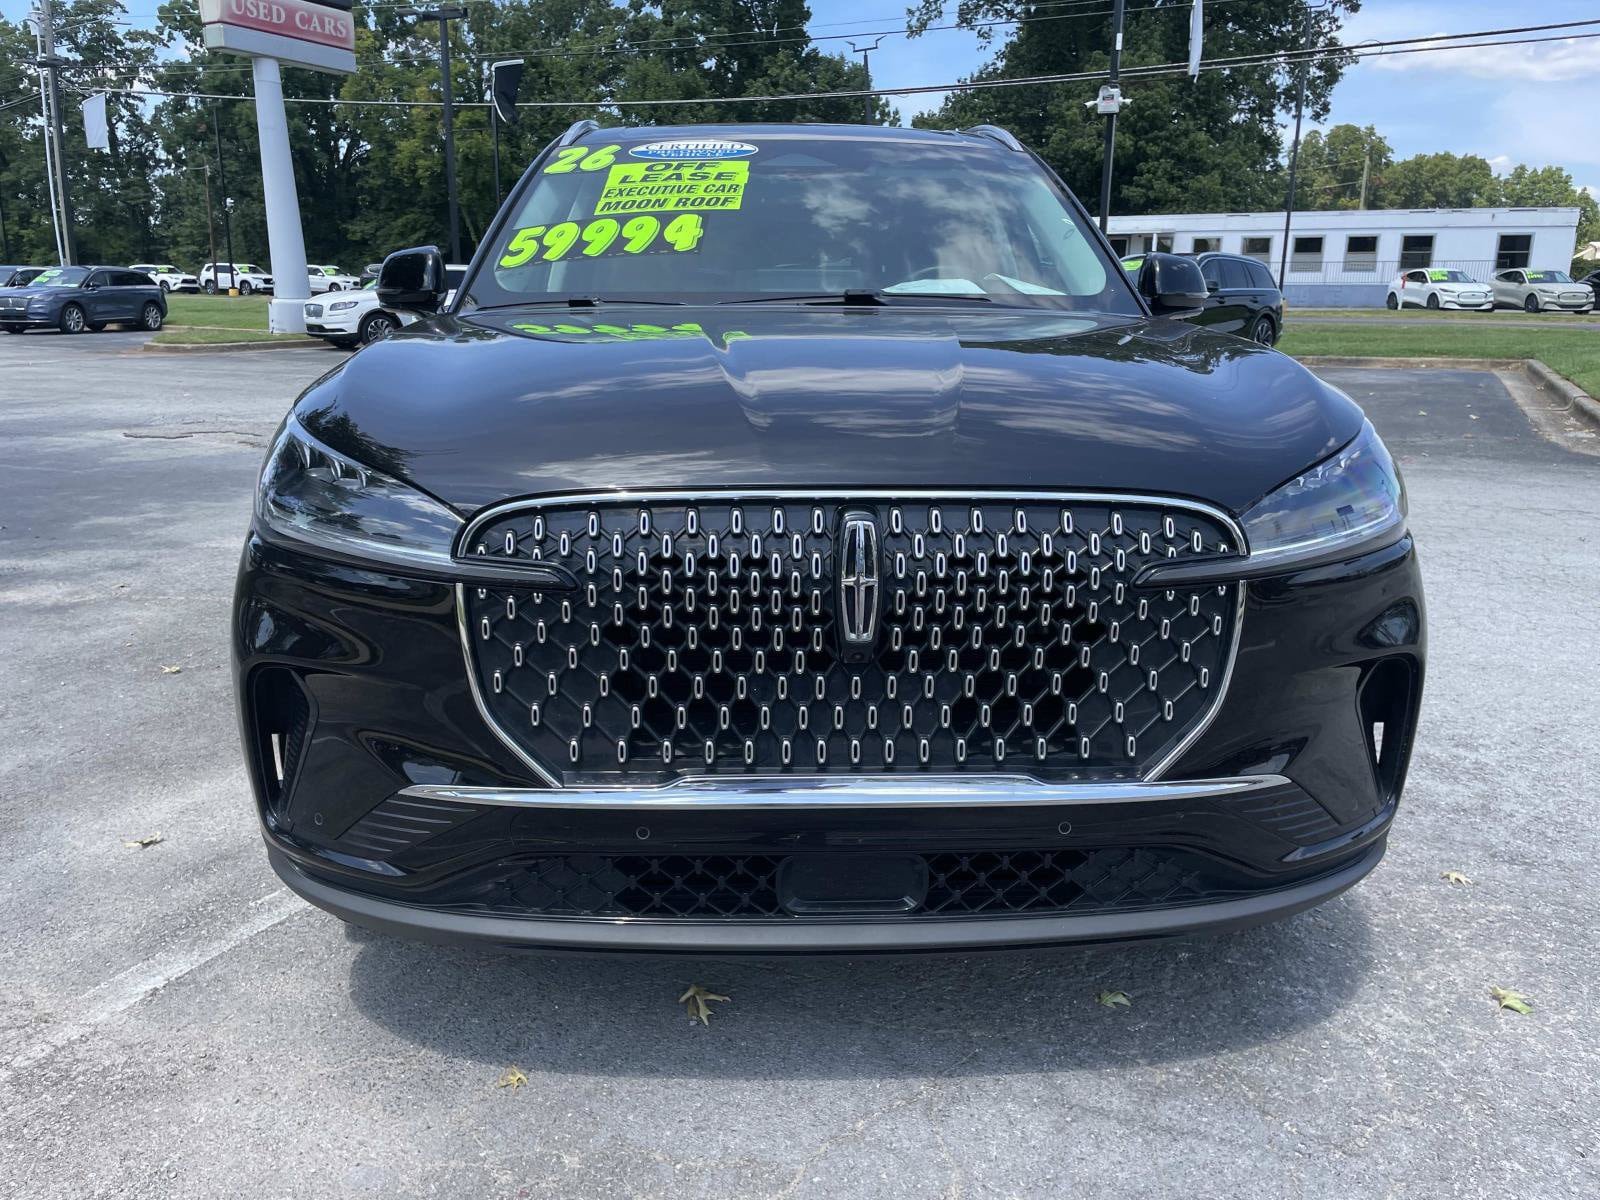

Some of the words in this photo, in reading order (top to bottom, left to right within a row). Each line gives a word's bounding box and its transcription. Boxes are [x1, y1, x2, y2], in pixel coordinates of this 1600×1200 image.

[231, 0, 286, 24] USED
[295, 11, 347, 38] CARS
[646, 142, 744, 151] CERTIFIED
[544, 144, 622, 174] 26
[645, 161, 722, 172] OFF
[618, 171, 738, 184] LEASE
[604, 184, 700, 199] EXECUTIVE
[703, 183, 741, 194] CAR
[600, 197, 669, 212] MOON
[674, 196, 737, 208] ROOF
[499, 213, 704, 268] 59994
